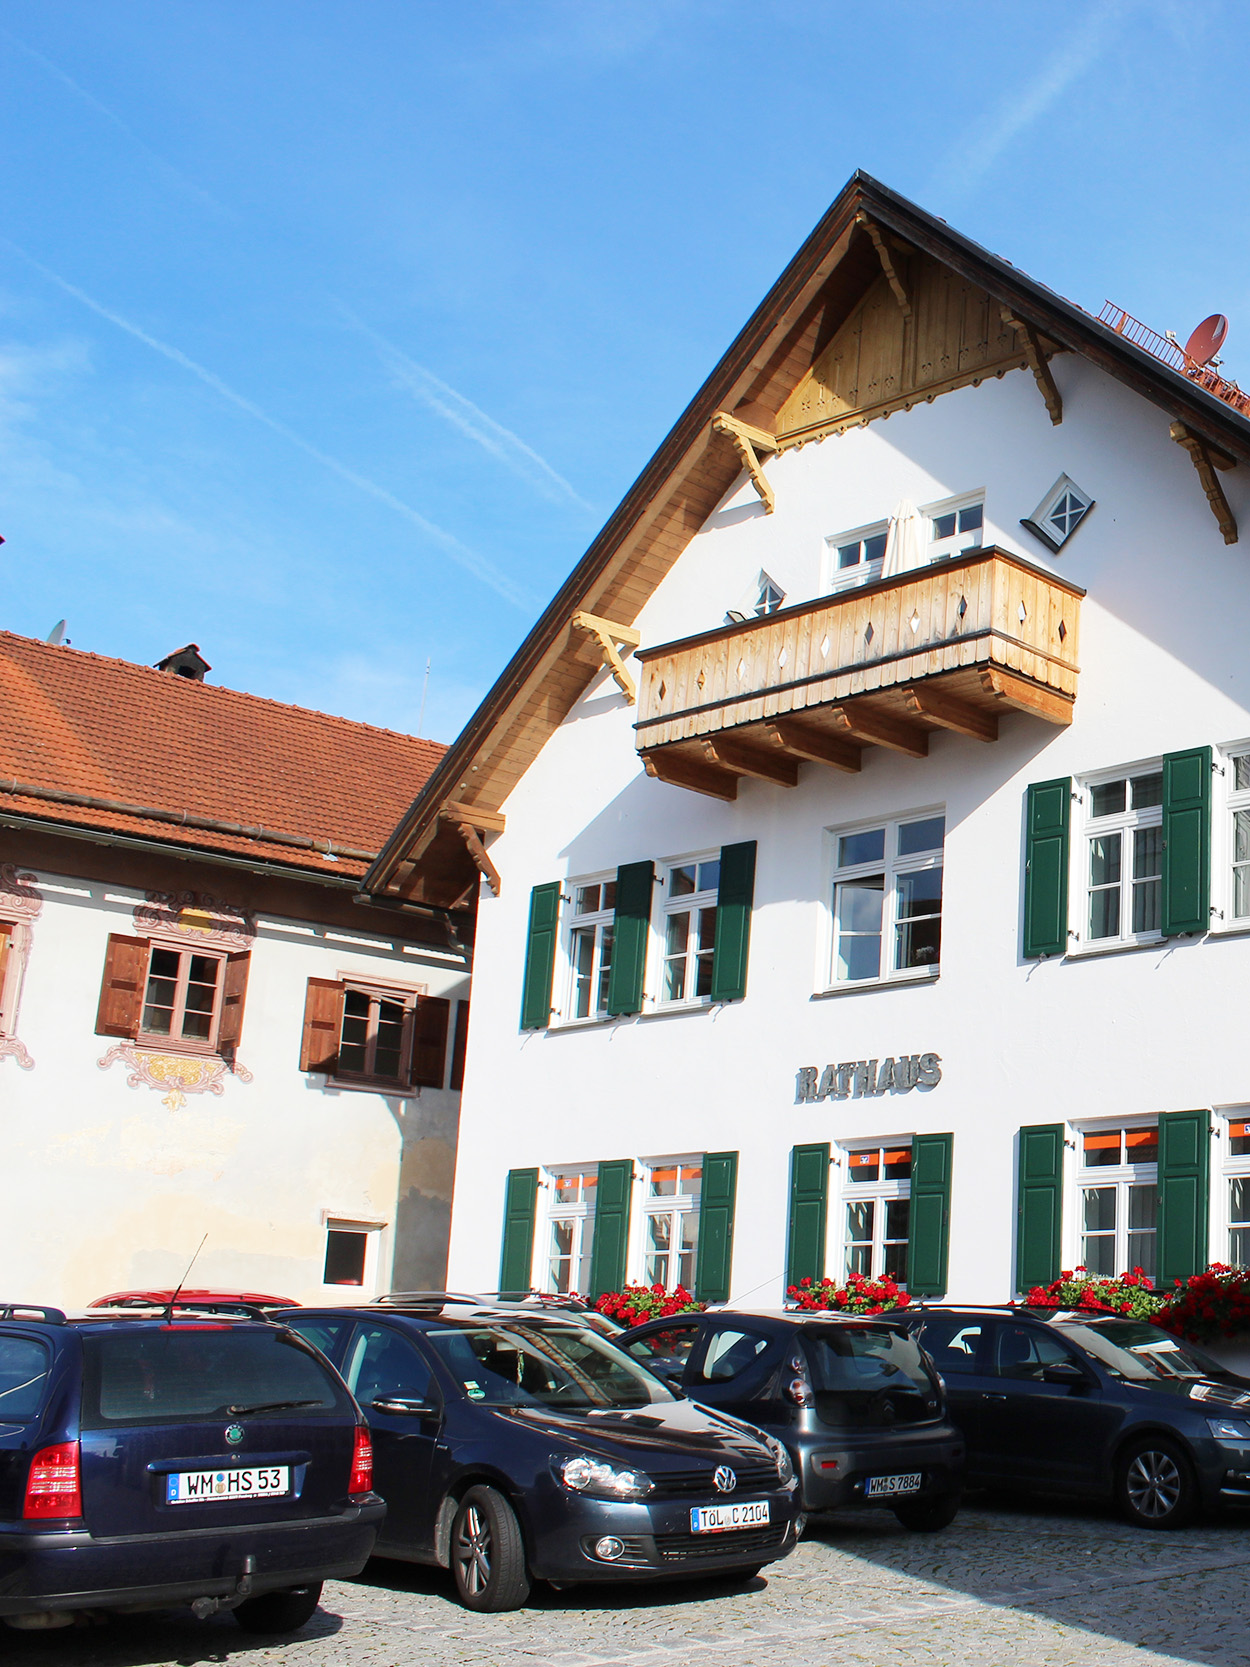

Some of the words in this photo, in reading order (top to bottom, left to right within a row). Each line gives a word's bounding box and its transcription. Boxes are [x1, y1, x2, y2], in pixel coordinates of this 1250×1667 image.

[798, 1052, 943, 1099] RATHAUS
[187, 1474, 213, 1496] WM
[227, 1471, 252, 1493] HS
[258, 1469, 281, 1490] 53
[870, 1479, 884, 1493] WM
[889, 1477, 896, 1491] S
[898, 1474, 920, 1490] 7884
[701, 1509, 724, 1527] TÖL
[733, 1507, 740, 1524] C
[742, 1504, 768, 1523] 2104
